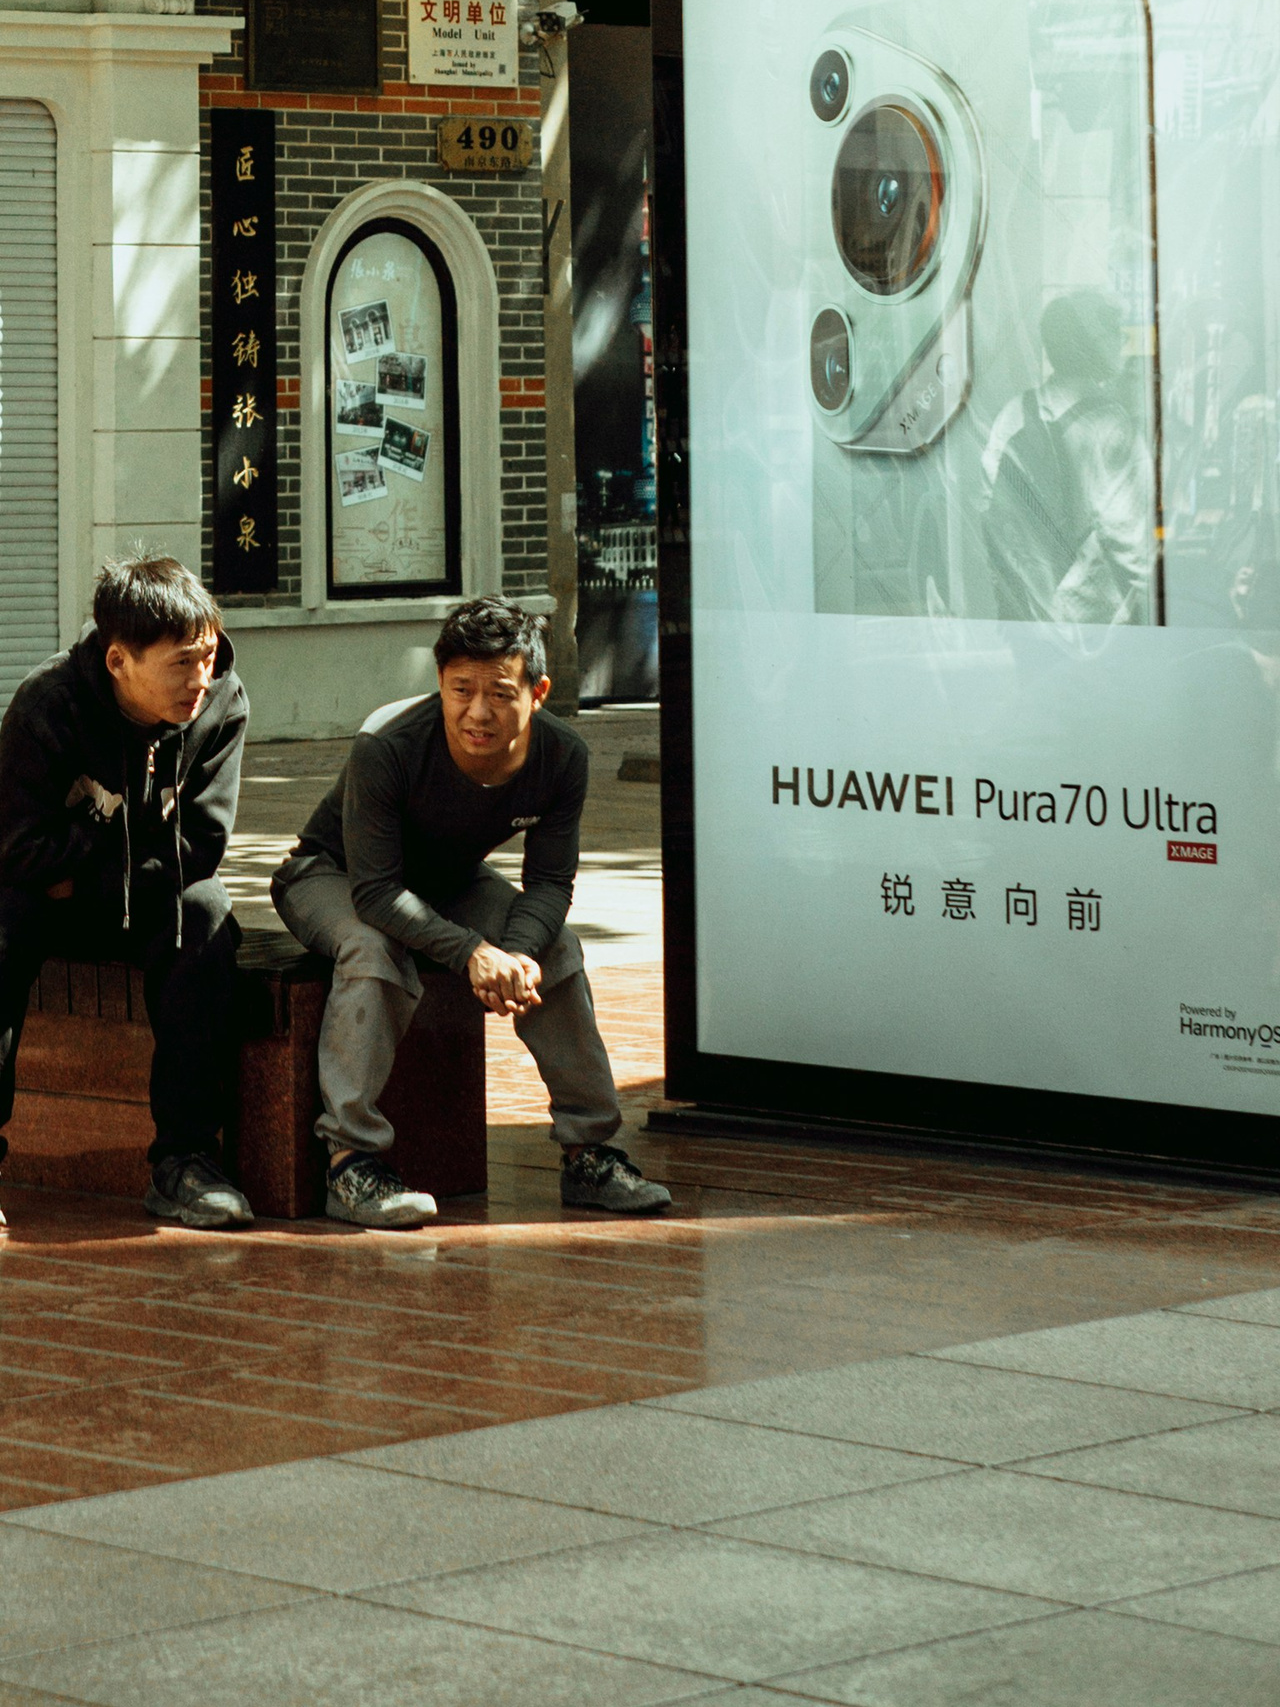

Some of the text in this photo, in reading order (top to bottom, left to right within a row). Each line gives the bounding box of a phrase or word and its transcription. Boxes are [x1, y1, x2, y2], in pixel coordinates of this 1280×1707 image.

[432, 27, 496, 41] Model Unit
[456, 125, 519, 151] 490
[772, 765, 1218, 835] HUAWEI Pura70 Ultra
[1170, 844, 1215, 861] XMAGE
[880, 872, 1103, 932] 锐意向前
[1179, 1002, 1237, 1022] Powered by
